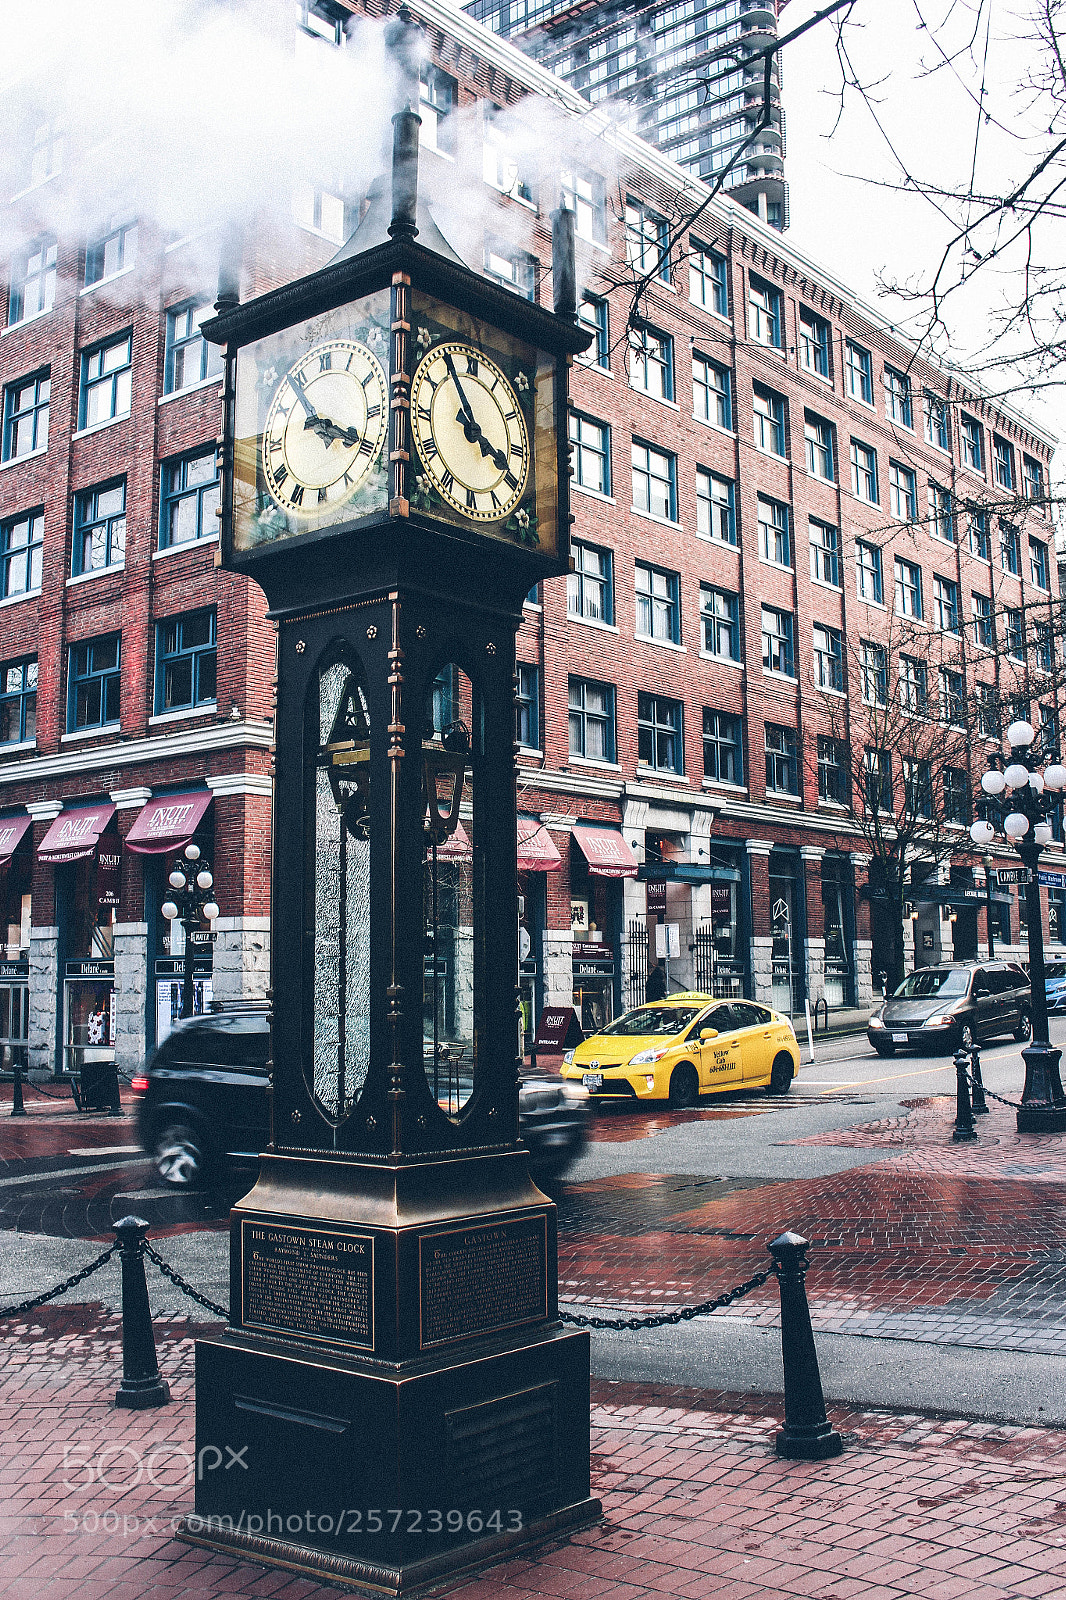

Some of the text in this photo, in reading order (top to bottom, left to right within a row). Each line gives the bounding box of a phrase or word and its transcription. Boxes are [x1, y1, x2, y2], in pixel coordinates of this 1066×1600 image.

[149, 804, 194, 822] INUIT
[59, 816, 99, 833] INUIT
[586, 838, 619, 852] INUIT
[99, 855, 121, 864] INUIT
[648, 884, 666, 893] INUIT
[714, 1050, 729, 1059] Yellow
[252, 1230, 266, 1240] THE
[268, 1232, 306, 1246] GASTOWN
[309, 1239, 334, 1250] STEAM
[337, 1242, 365, 1254] CLOCK
